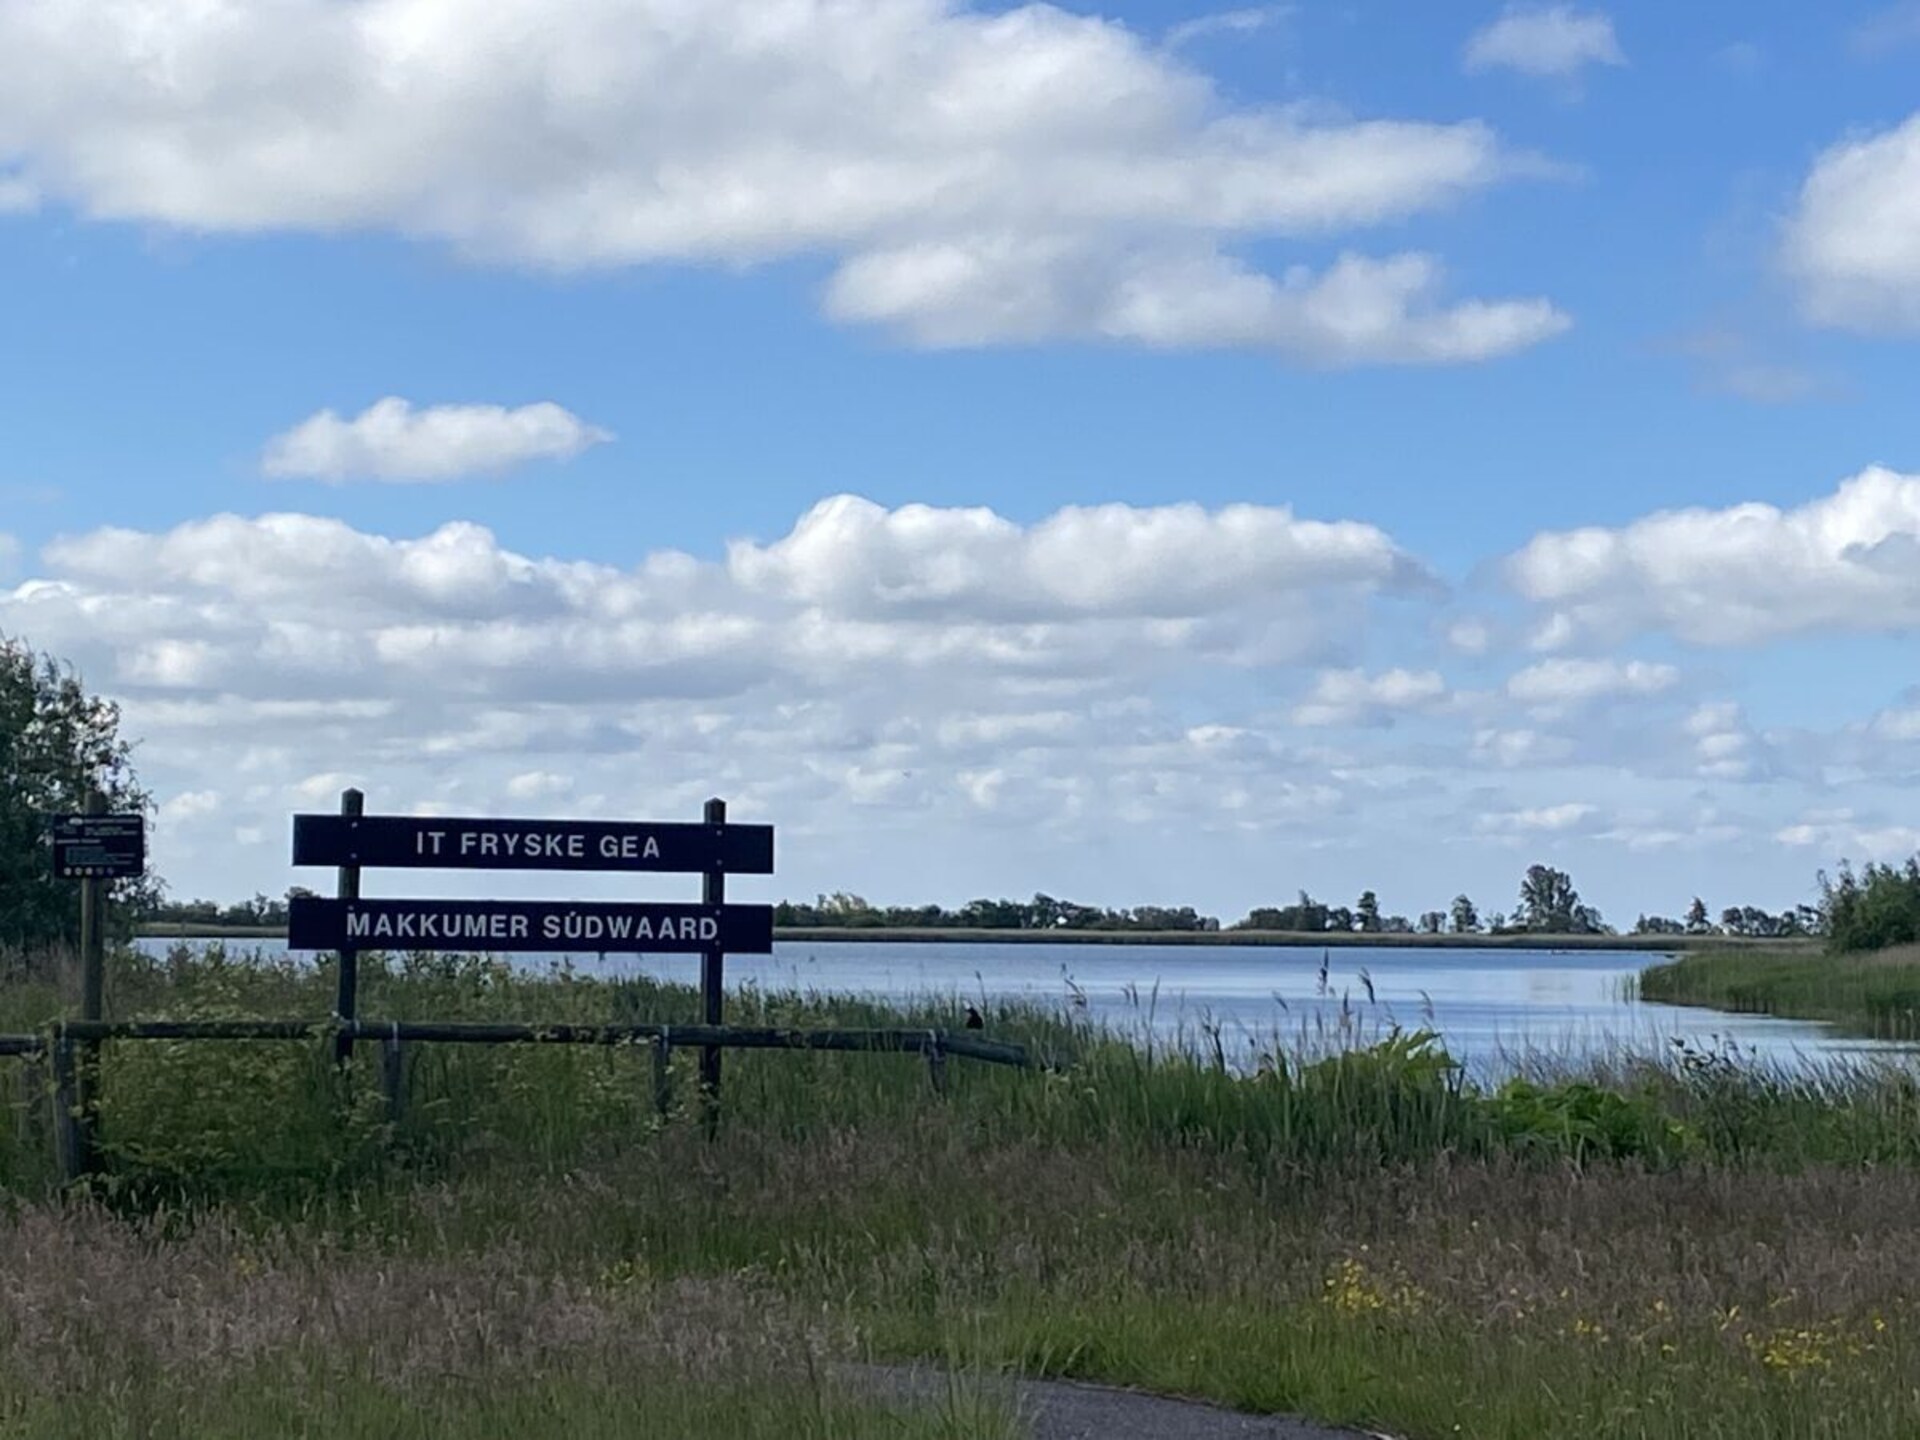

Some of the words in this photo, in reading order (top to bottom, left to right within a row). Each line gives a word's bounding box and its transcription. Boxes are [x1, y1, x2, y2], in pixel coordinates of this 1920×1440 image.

[416, 831, 446, 854] IT
[461, 832, 584, 858] FRYSKE
[599, 836, 661, 859] GEA
[347, 912, 529, 938] MAKKUMER
[542, 911, 718, 940] SÚDWAARD
